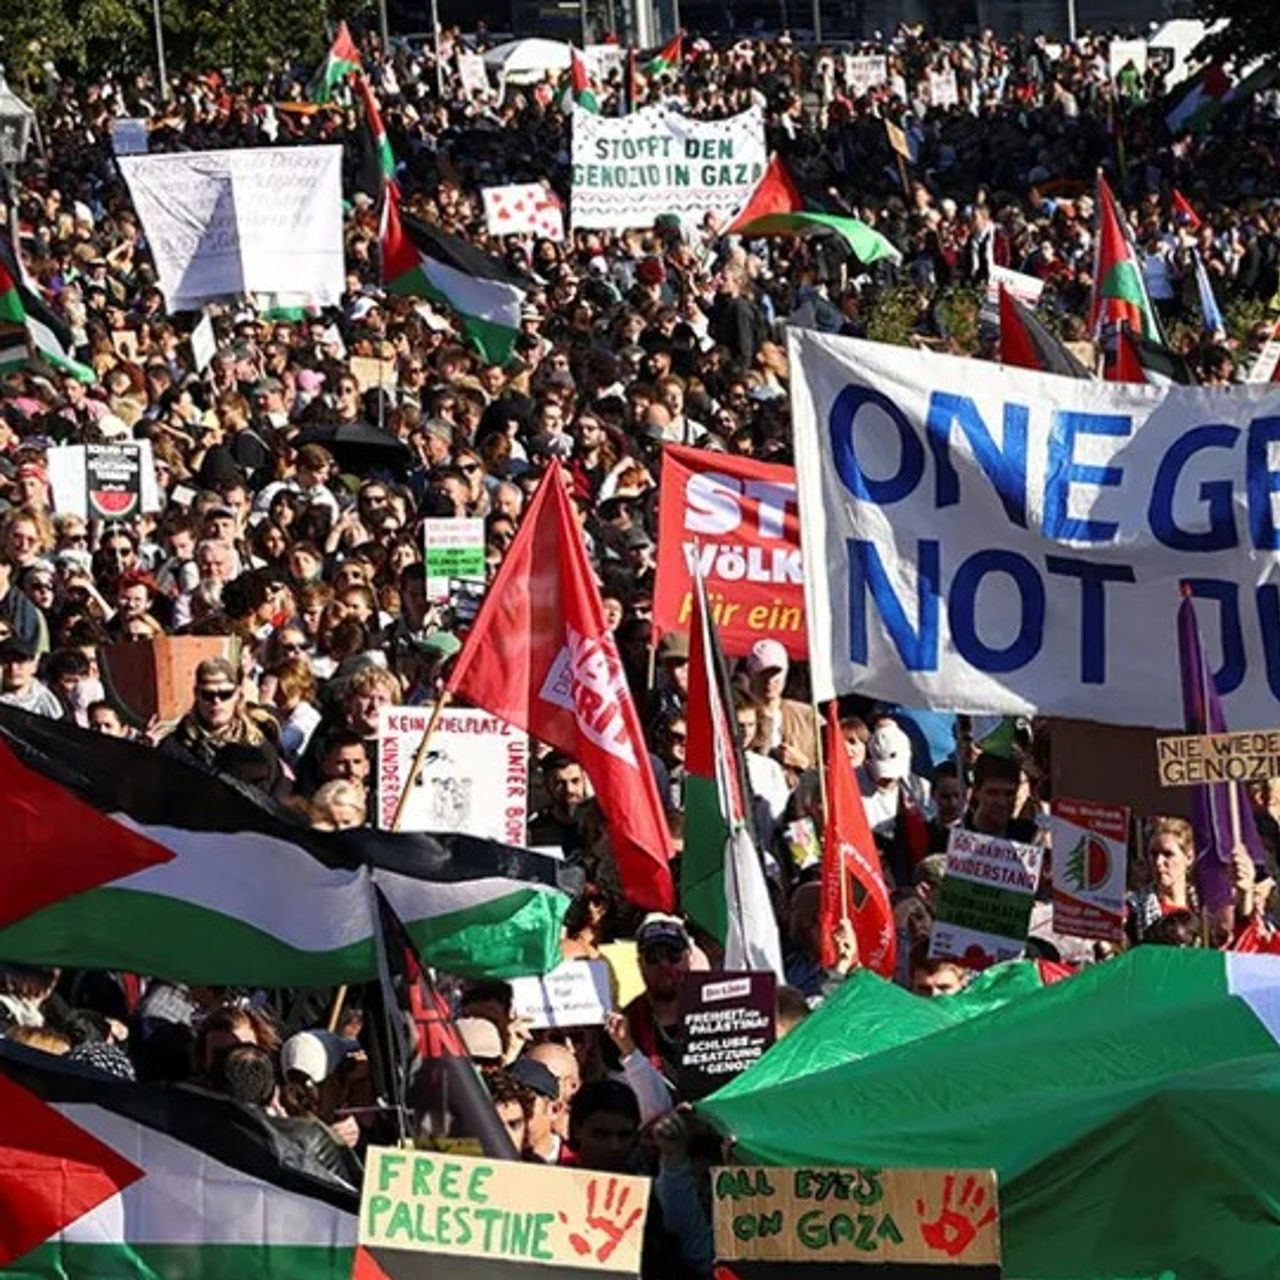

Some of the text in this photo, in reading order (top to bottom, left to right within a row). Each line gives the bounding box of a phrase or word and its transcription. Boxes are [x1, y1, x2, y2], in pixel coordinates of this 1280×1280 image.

[684, 138, 733, 160] DEN
[666, 164, 690, 186] IN
[701, 162, 762, 187] GAZA
[829, 383, 1133, 544] ONE
[847, 540, 1135, 684] NOT
[388, 715, 425, 732] KEIN
[507, 741, 527, 798] UNTER
[1160, 738, 1202, 759] NIE
[378, 1153, 494, 1204] FREE
[715, 1169, 884, 1207] ALL EYES
[368, 1195, 556, 1260] PALESTINE
[732, 1209, 904, 1251] ON GAZA
